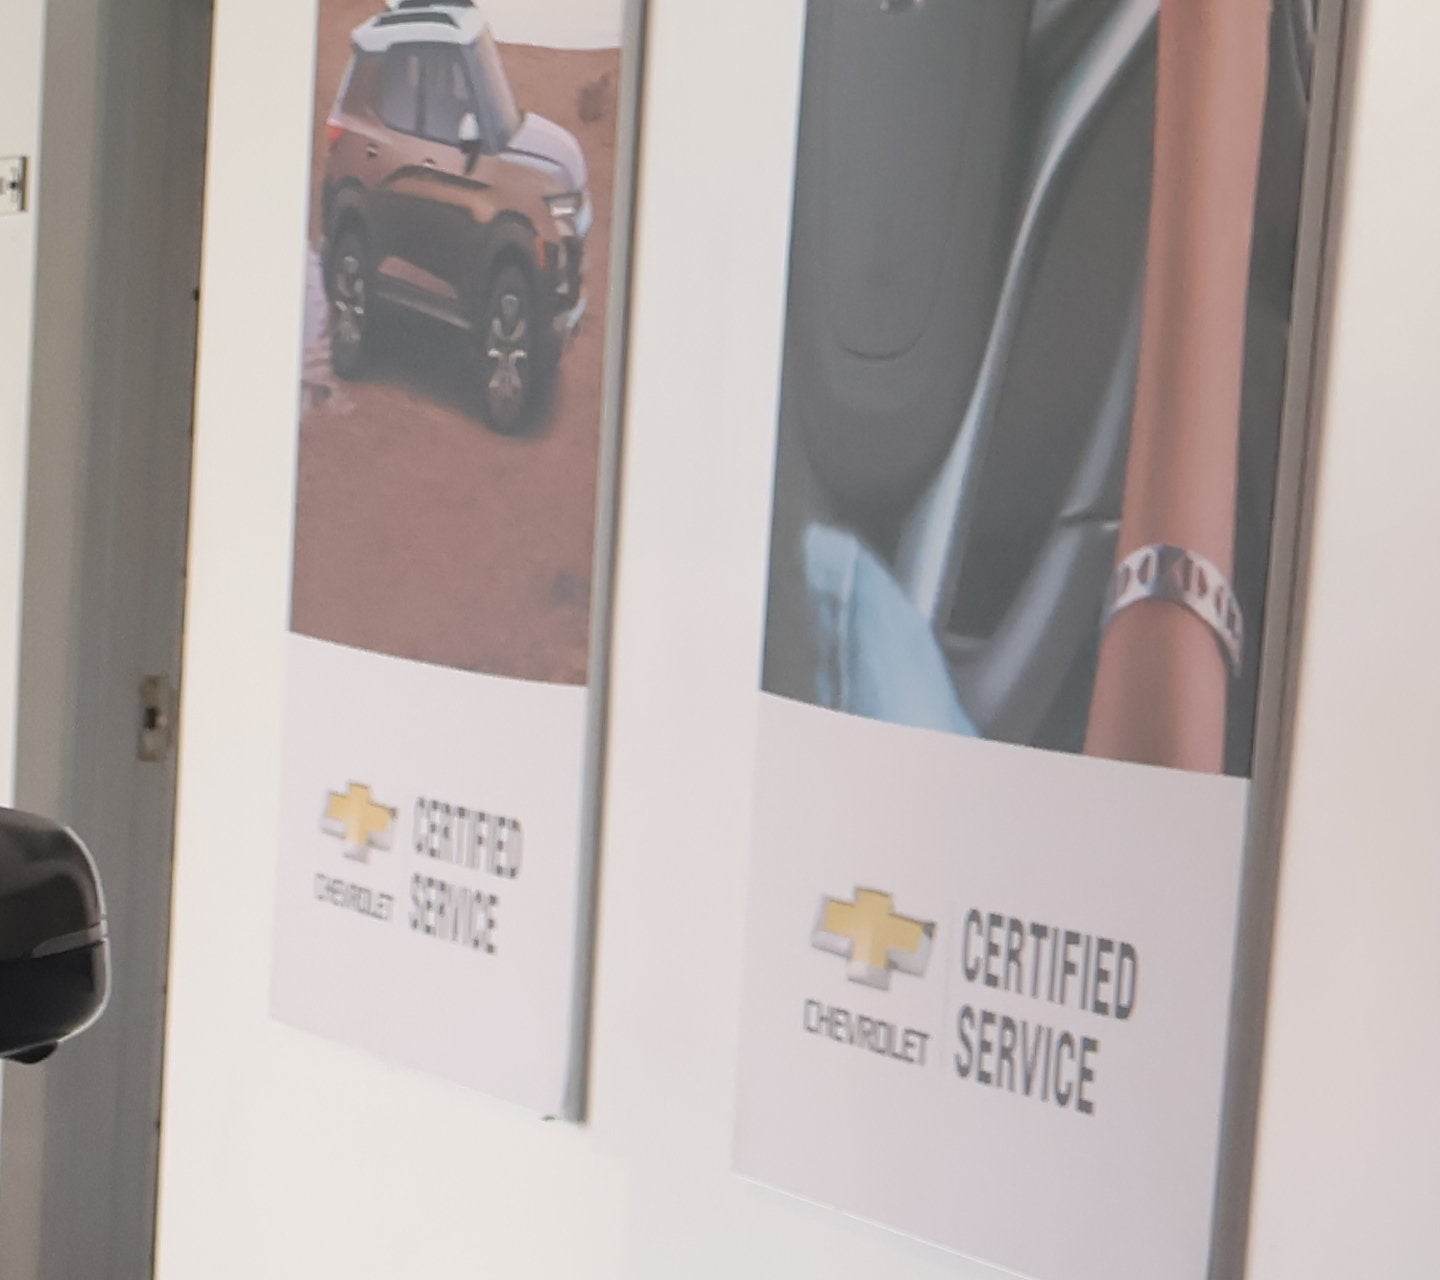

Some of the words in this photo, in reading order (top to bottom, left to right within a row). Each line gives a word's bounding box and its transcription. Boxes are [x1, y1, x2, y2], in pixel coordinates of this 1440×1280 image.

[412, 796, 524, 880] CERTIFIED
[313, 872, 395, 923] CHEVROLET
[408, 872, 500, 956] SERVICE
[961, 907, 1139, 1020] CERTIFIED
[802, 997, 930, 1067] CHEVROLET
[953, 1003, 1101, 1116] SERVICE
